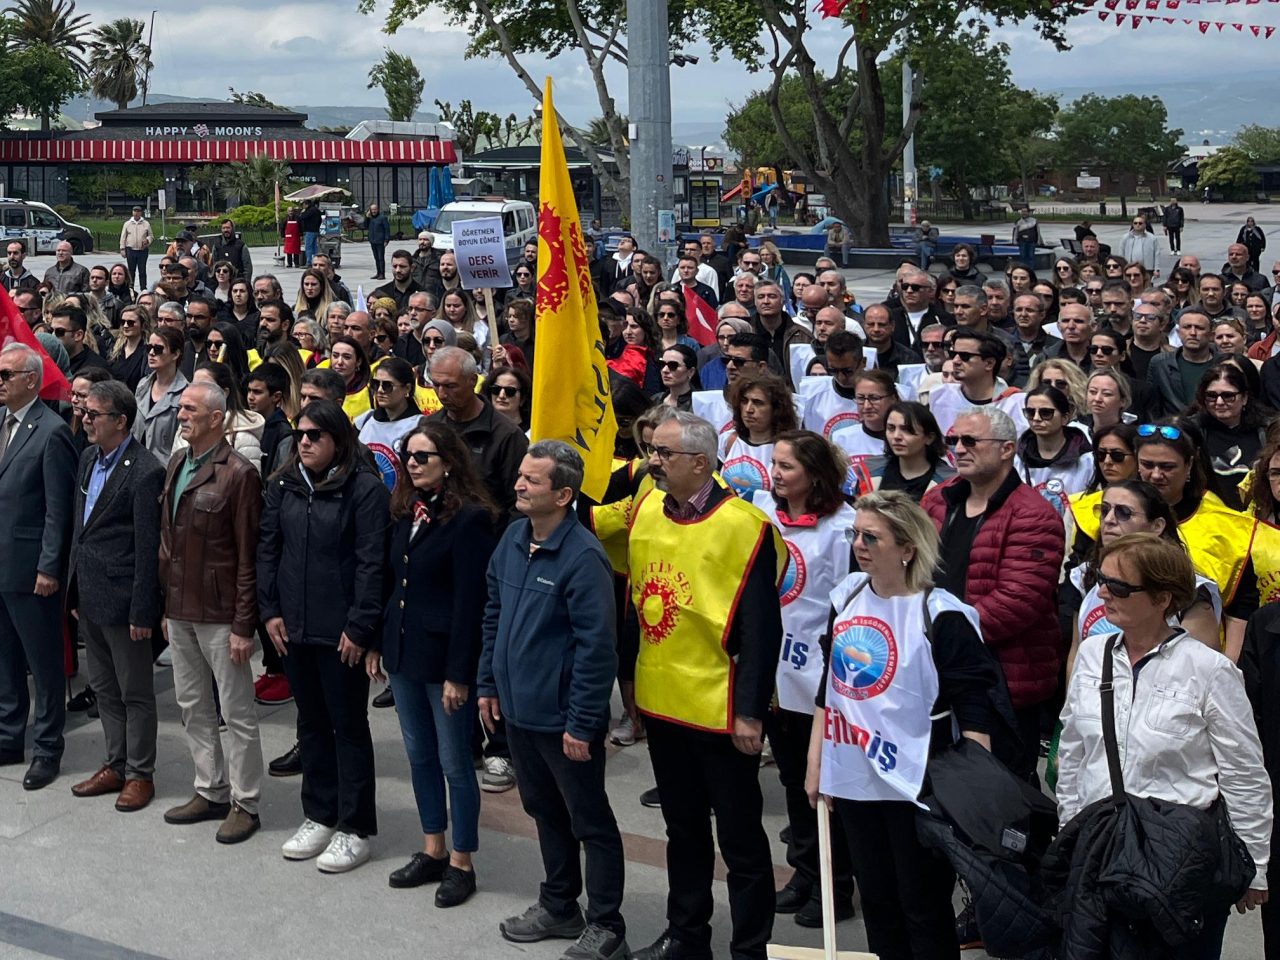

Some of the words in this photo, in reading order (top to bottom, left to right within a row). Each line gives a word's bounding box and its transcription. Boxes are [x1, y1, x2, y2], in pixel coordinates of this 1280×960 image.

[145, 126, 188, 136] HAPPY
[215, 126, 262, 136] MOON'S
[462, 228, 495, 237] ÖĞRETMEN
[458, 238, 478, 246] BOYUN
[480, 236, 500, 245] EĞMEZ
[468, 255, 495, 266] DERS
[470, 267, 500, 279] VERİR
